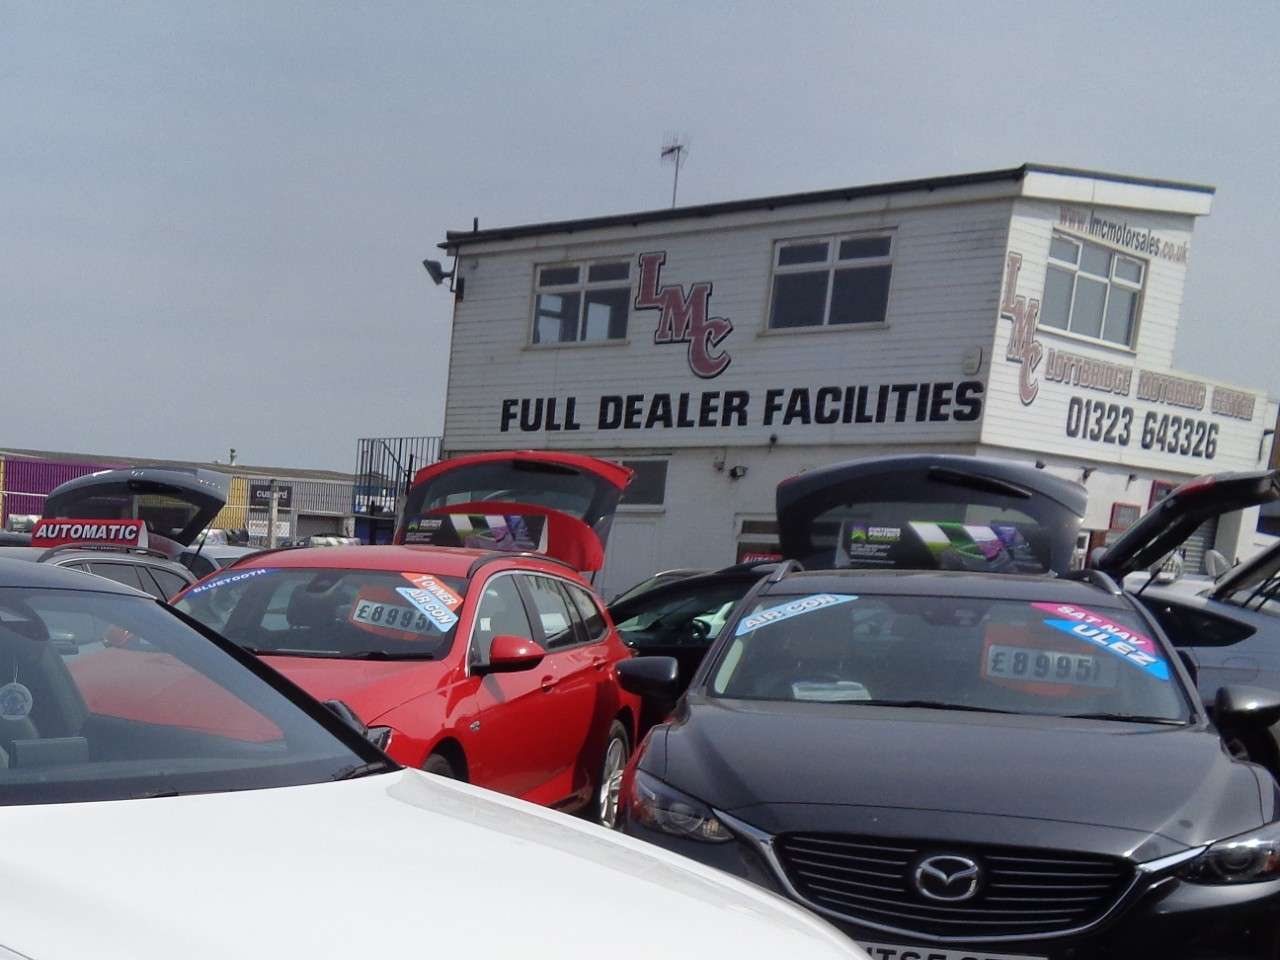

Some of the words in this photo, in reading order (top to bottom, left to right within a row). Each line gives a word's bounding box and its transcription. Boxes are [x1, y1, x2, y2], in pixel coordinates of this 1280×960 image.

[1060, 207, 1188, 262] www.lmcmotorsales.co.uk
[635, 251, 733, 379] LMC
[1001, 251, 1043, 406] LMC
[1045, 348, 1133, 397] LOTTBRIDGE
[1136, 369, 1206, 411] MOTORING
[500, 397, 580, 432] FULL
[598, 390, 750, 430] DEALER
[763, 381, 984, 426] FACILITIES
[1066, 396, 1134, 447] 01323
[1141, 411, 1220, 460] 643326
[256, 490, 288, 499] cusrd
[35, 524, 137, 540] AUTOMATIC
[193, 568, 266, 593] BLUETOOTH
[408, 590, 431, 604] AIR
[424, 604, 453, 625] CON
[745, 609, 782, 629] AIR
[1057, 605, 1103, 624] SAT
[1100, 624, 1148, 646] NAV
[1071, 623, 1158, 666] ULEZ
[991, 651, 1092, 684] £8995
